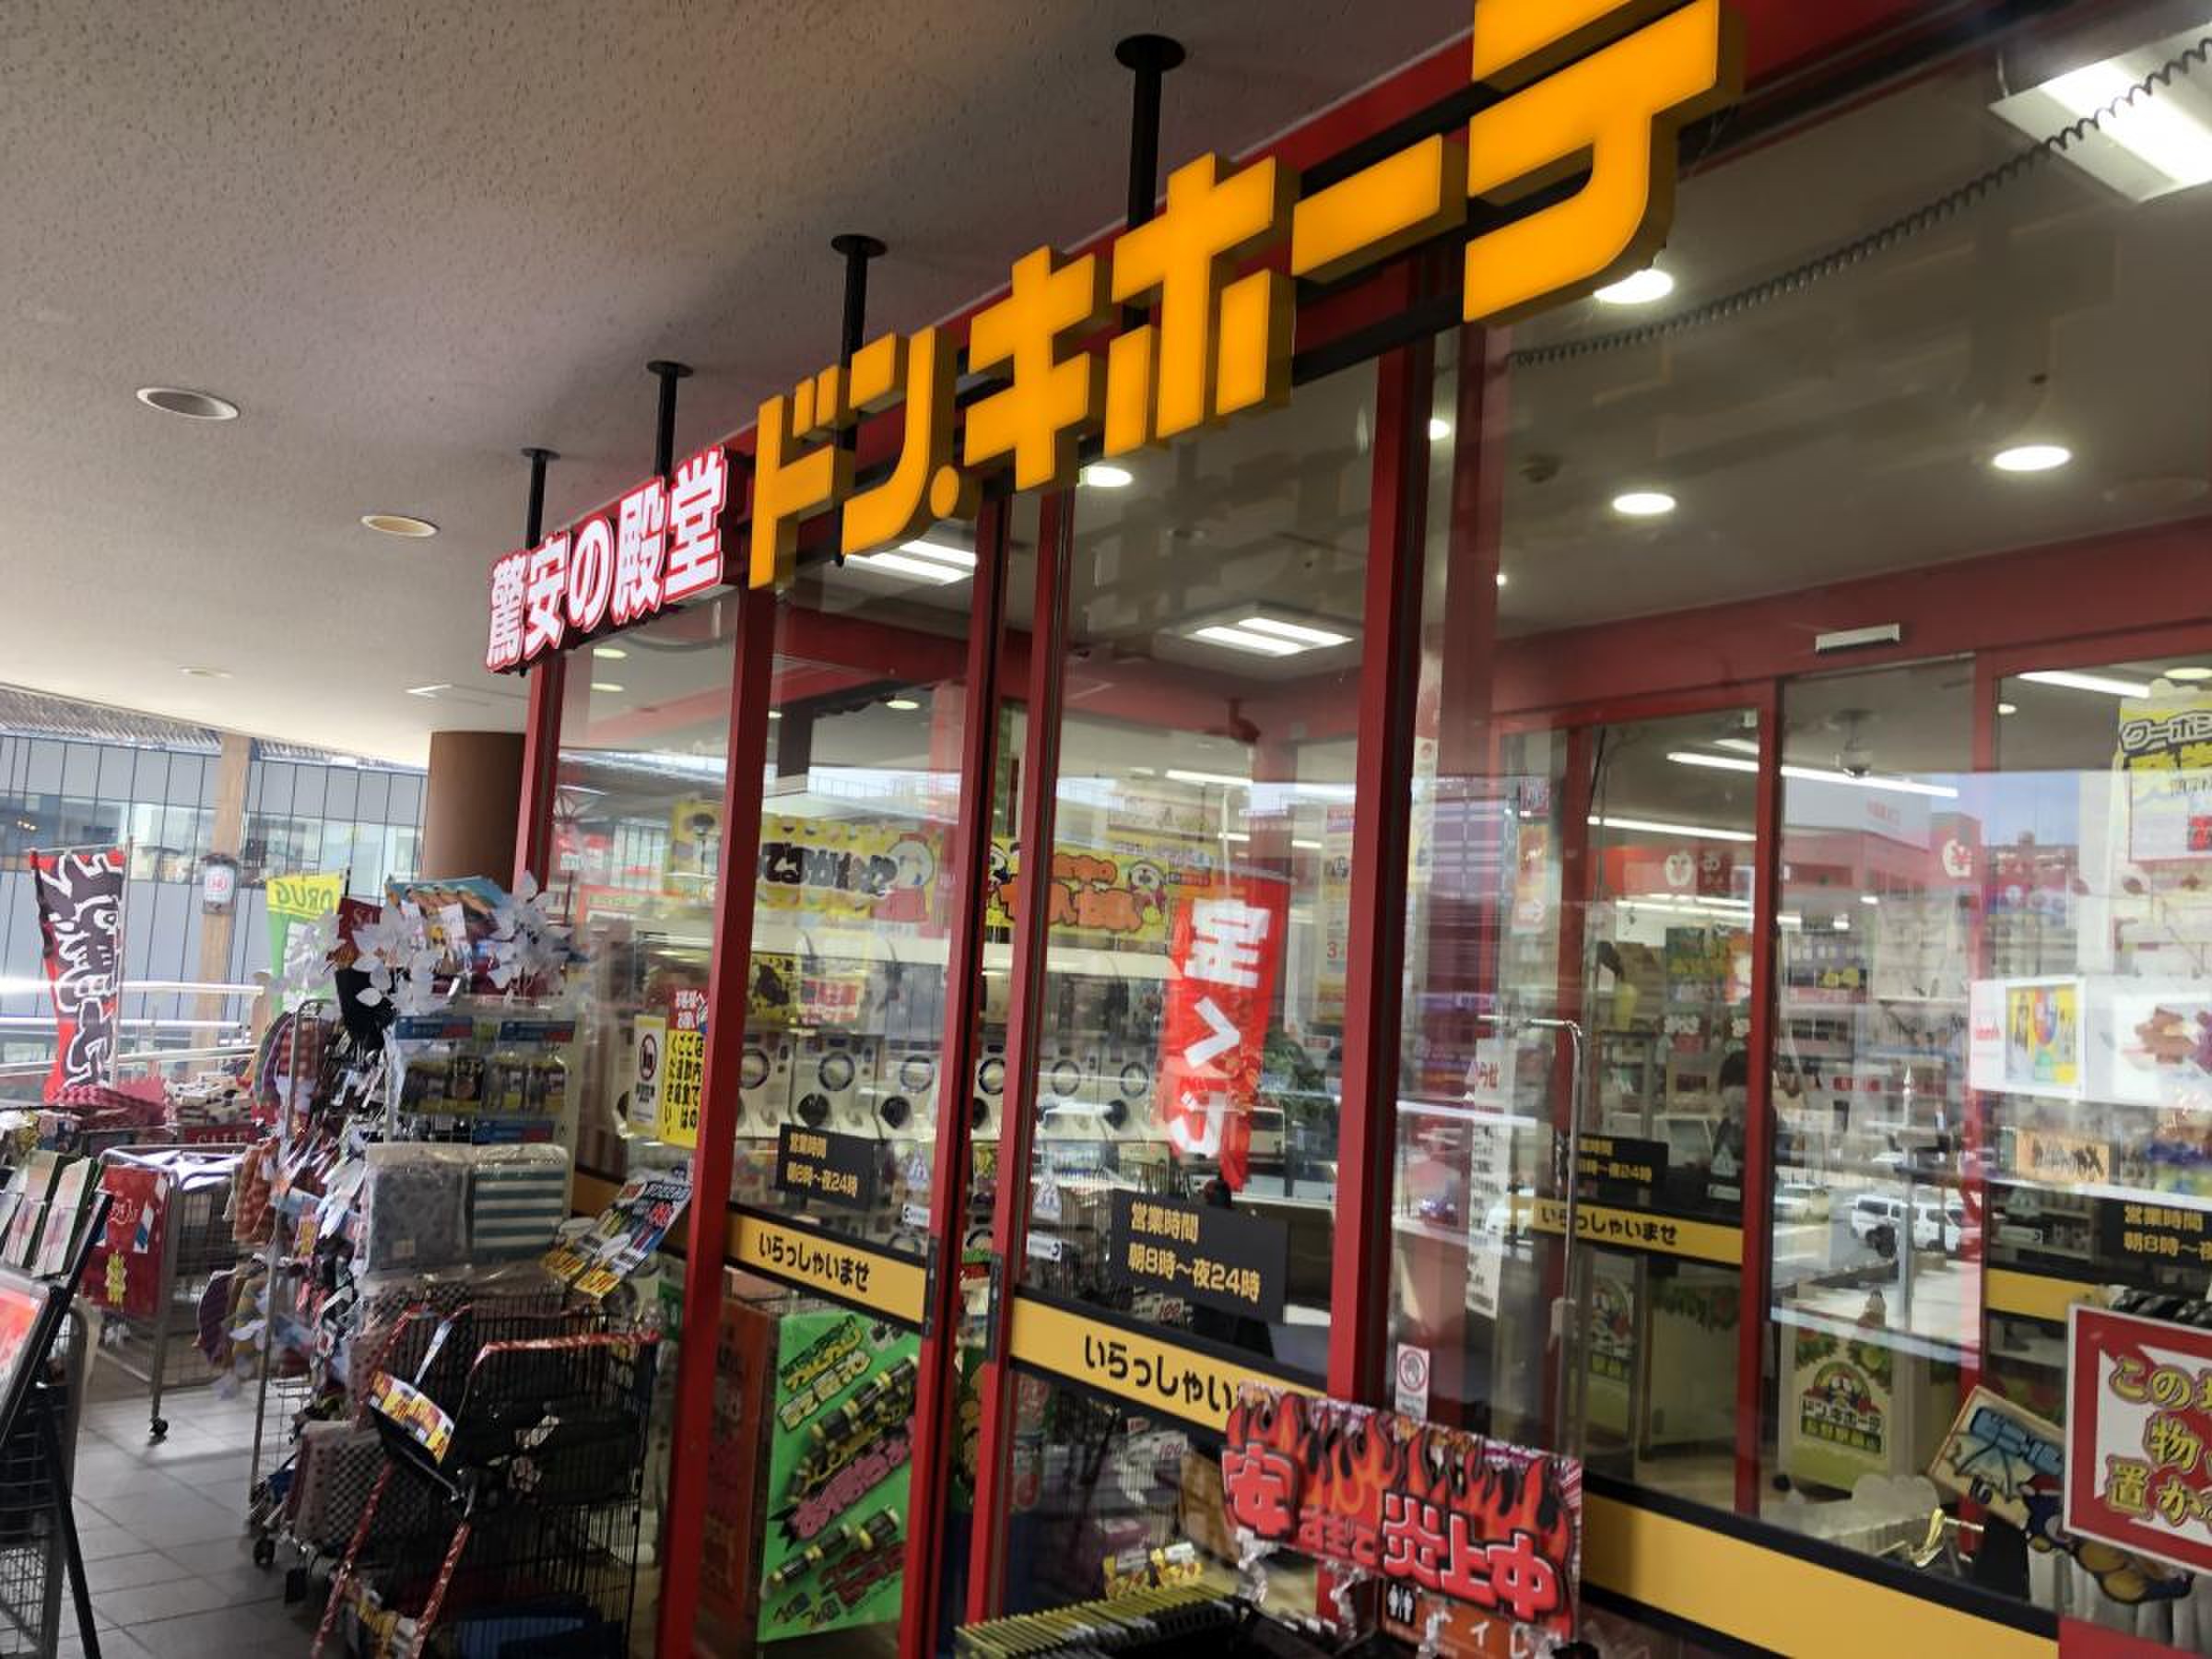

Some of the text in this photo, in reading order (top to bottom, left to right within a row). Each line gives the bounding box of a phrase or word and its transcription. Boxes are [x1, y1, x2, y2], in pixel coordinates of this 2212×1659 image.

[487, 446, 728, 673] 驚安の殿堂
[1130, 1201, 1198, 1244] 営業時間
[2124, 1204, 2204, 1233] 営業時間
[759, 1231, 871, 1292] いらっしゃいませ
[1084, 1335, 1241, 1413] いらっしゃい
[2148, 1417, 2212, 1475] 物
[2108, 1460, 2212, 1525] 置か
